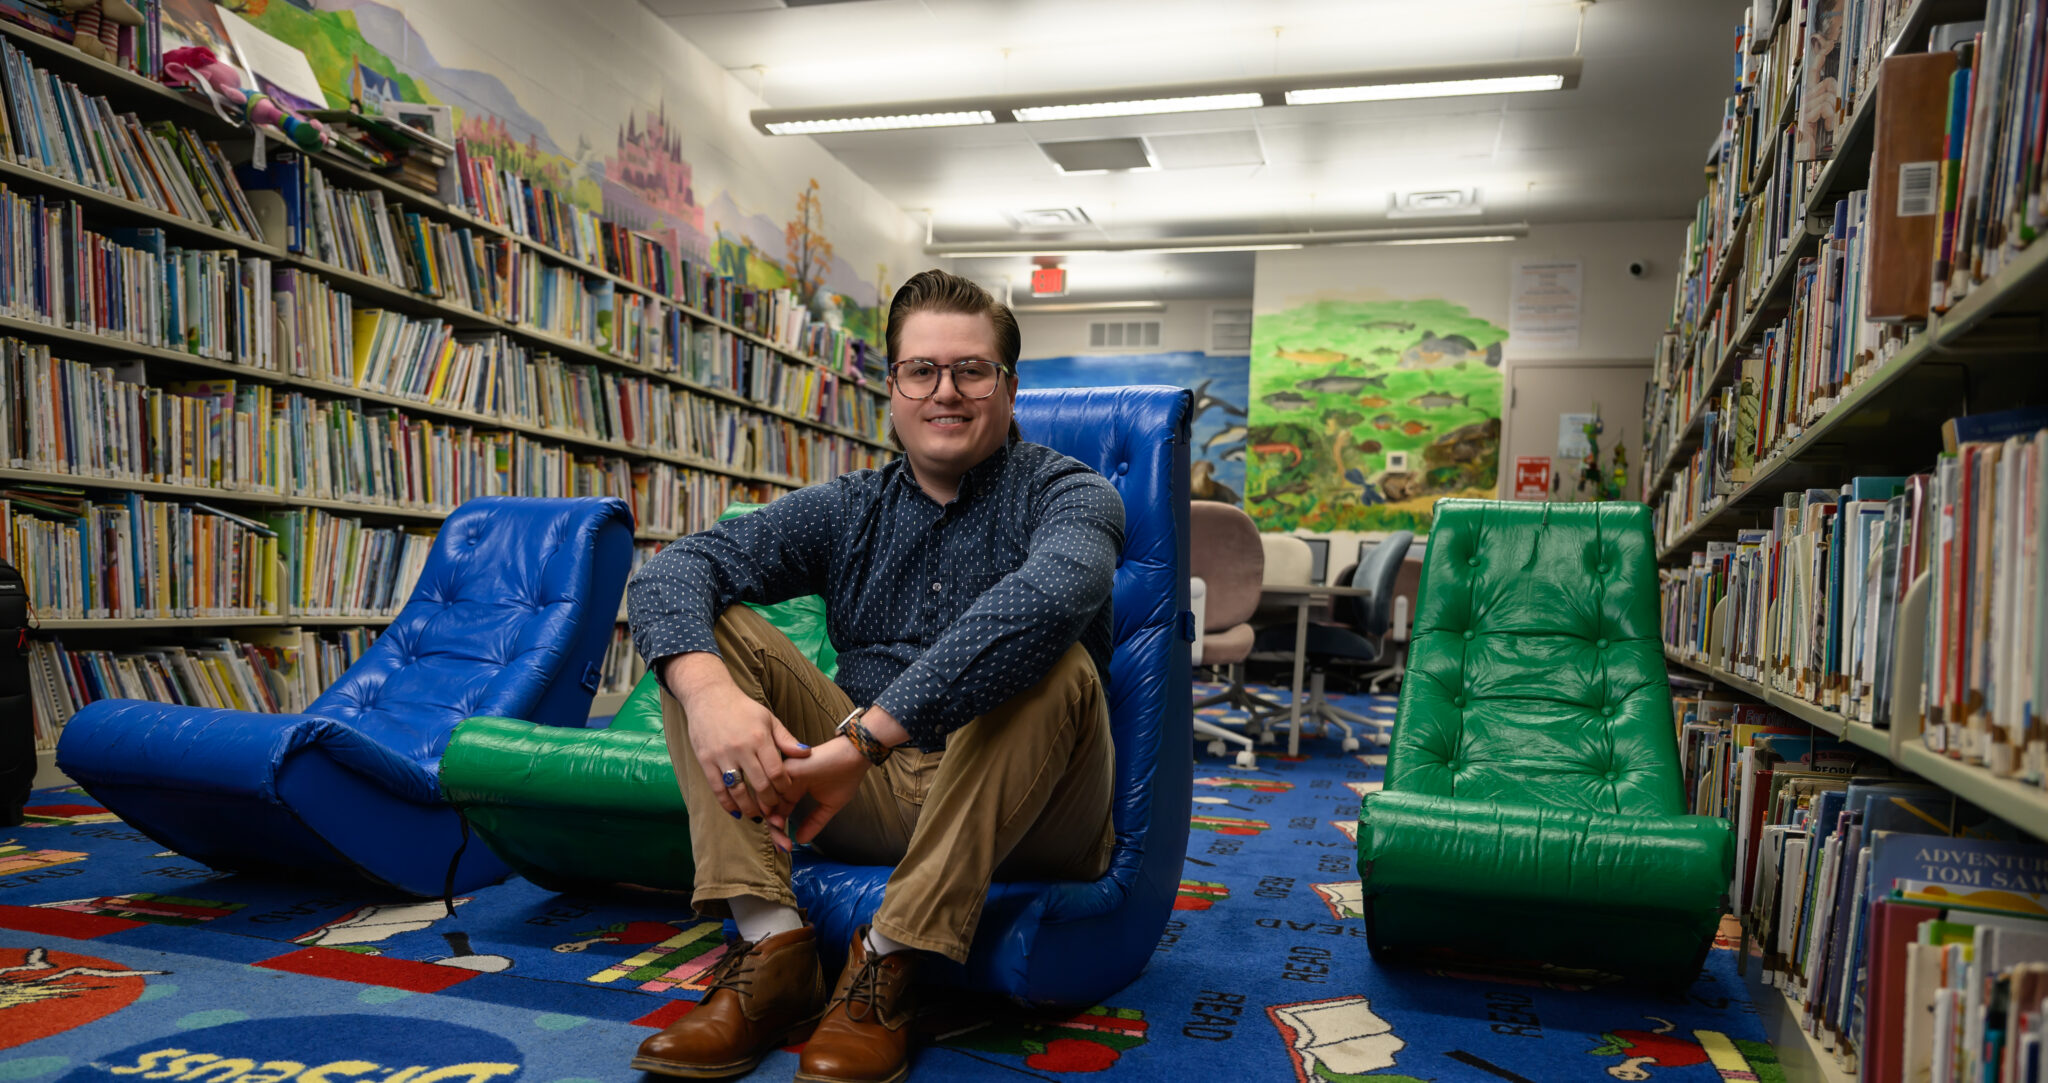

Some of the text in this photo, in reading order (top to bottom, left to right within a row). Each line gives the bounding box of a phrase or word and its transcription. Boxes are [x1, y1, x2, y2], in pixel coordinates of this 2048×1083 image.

[1254, 876, 1295, 898] READ
[1922, 864, 1981, 885] TOM
[1282, 946, 1332, 984] READ
[1184, 990, 1246, 1042] READ
[1487, 991, 1543, 1038] READ
